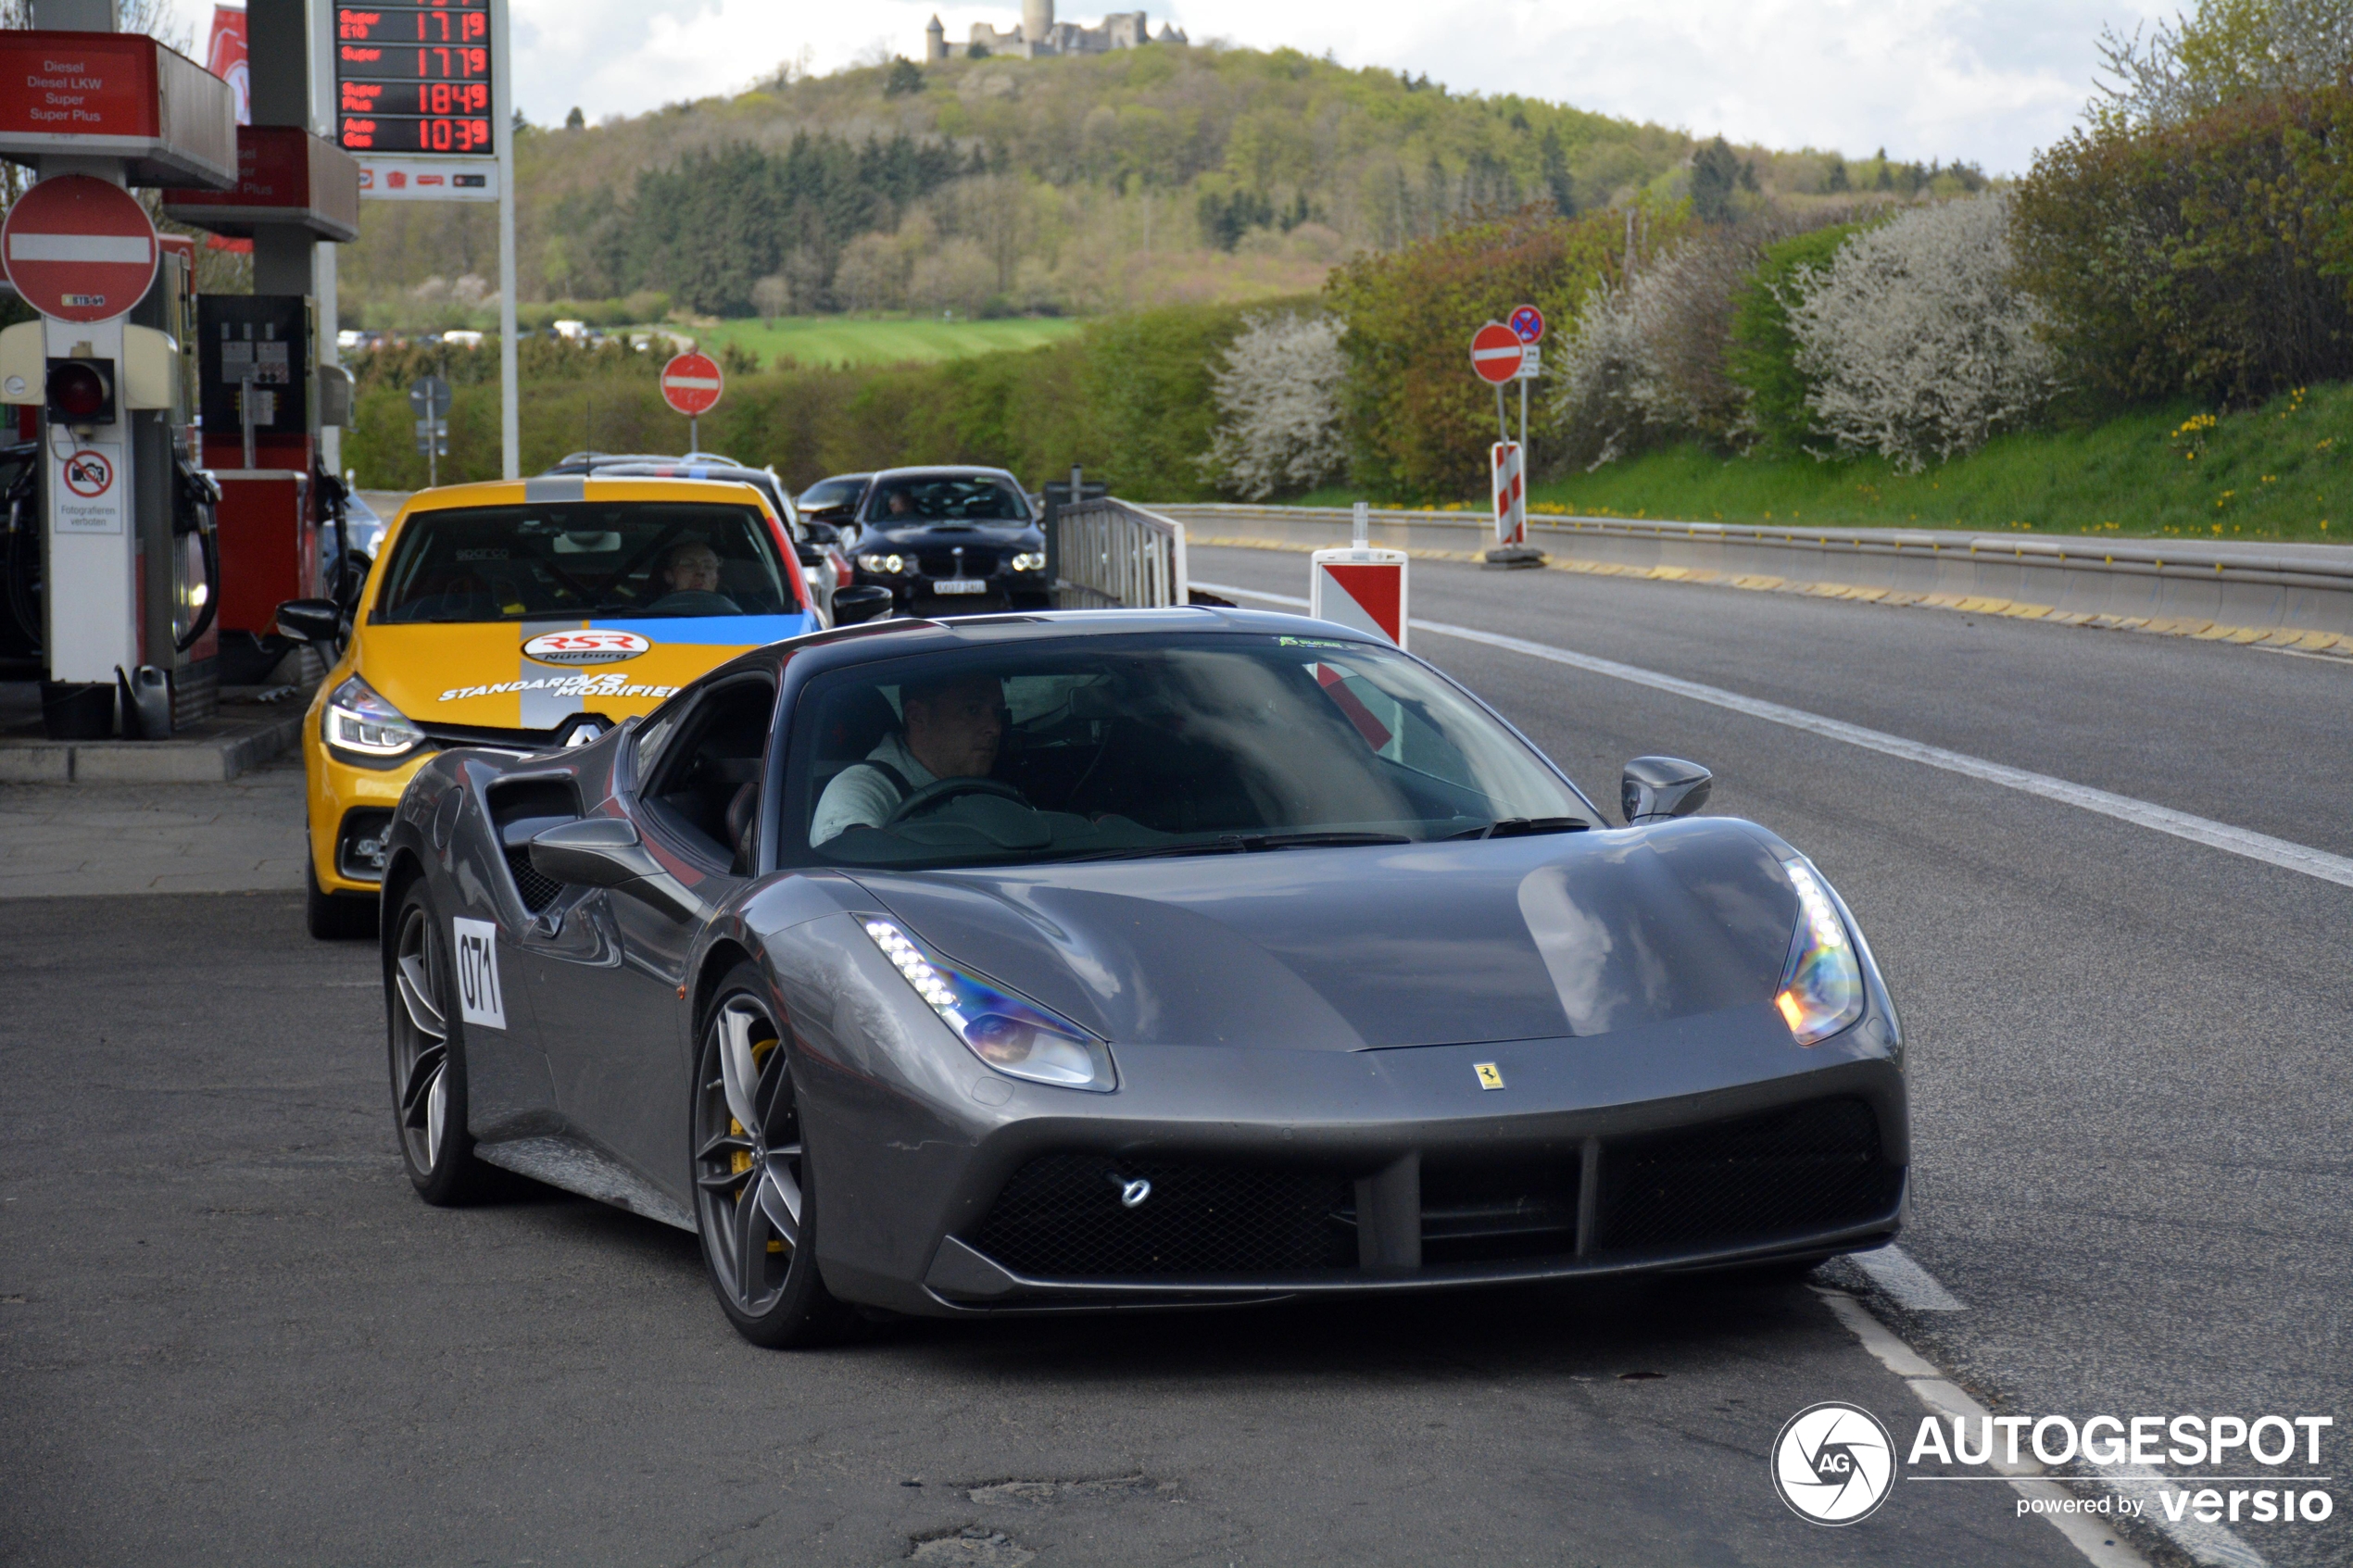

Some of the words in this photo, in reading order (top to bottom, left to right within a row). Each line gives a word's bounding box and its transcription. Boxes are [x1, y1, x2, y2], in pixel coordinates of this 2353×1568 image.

[340, 9, 381, 25] Super
[340, 24, 369, 39] E10
[341, 45, 382, 62] Super
[44, 60, 84, 72] Diesel
[27, 76, 68, 88] Diesel
[70, 78, 102, 89] LKW
[342, 82, 383, 97] Super
[45, 93, 84, 106] Super
[342, 95, 373, 112] Plus
[30, 107, 69, 121] Super
[72, 109, 101, 121] Plus
[344, 118, 376, 133] Auto
[243, 182, 273, 195] Plus
[60, 504, 116, 516] Fotografieren
[70, 518, 107, 526] verboten
[455, 548, 510, 560] sparco
[541, 635, 635, 649] RSR
[544, 652, 627, 660] Nürburg
[437, 676, 583, 702] STANDARD
[575, 673, 629, 687] VS
[460, 934, 497, 1014] 071
